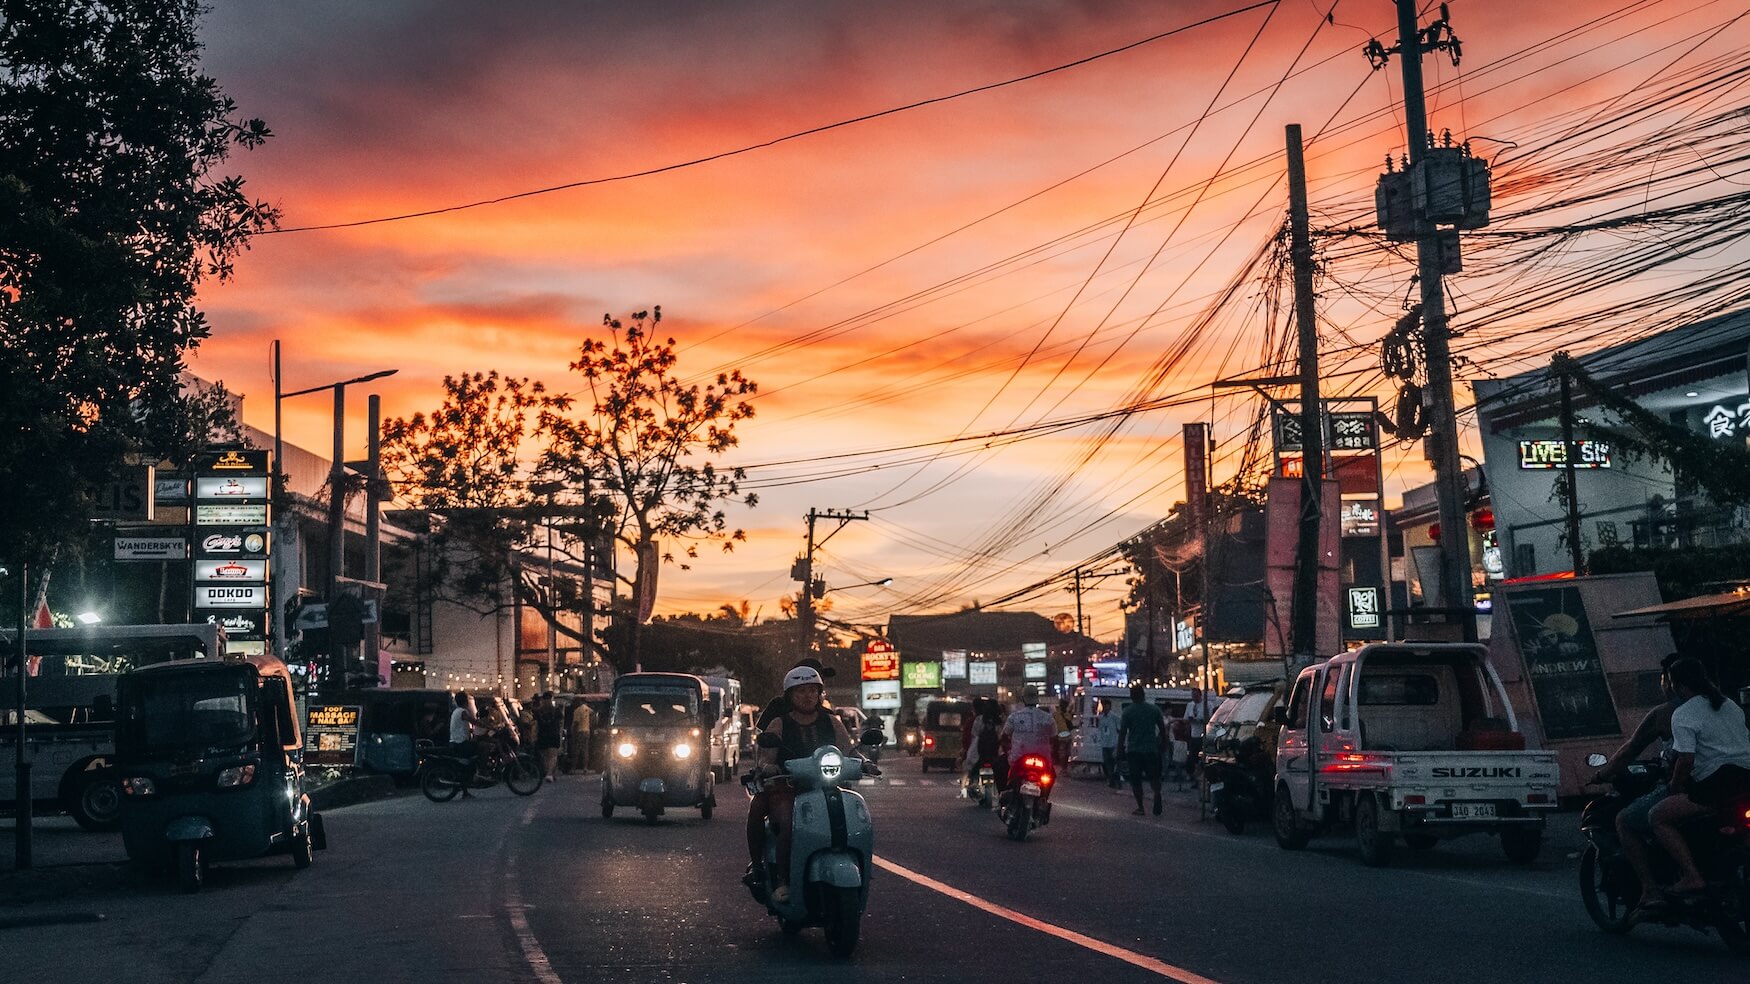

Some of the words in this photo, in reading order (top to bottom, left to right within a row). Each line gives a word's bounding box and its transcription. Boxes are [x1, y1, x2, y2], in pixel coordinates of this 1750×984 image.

[117, 541, 184, 550] WANDERSKYE
[309, 711, 357, 719] MASSAGE
[1431, 767, 1521, 778] SUZUKI
